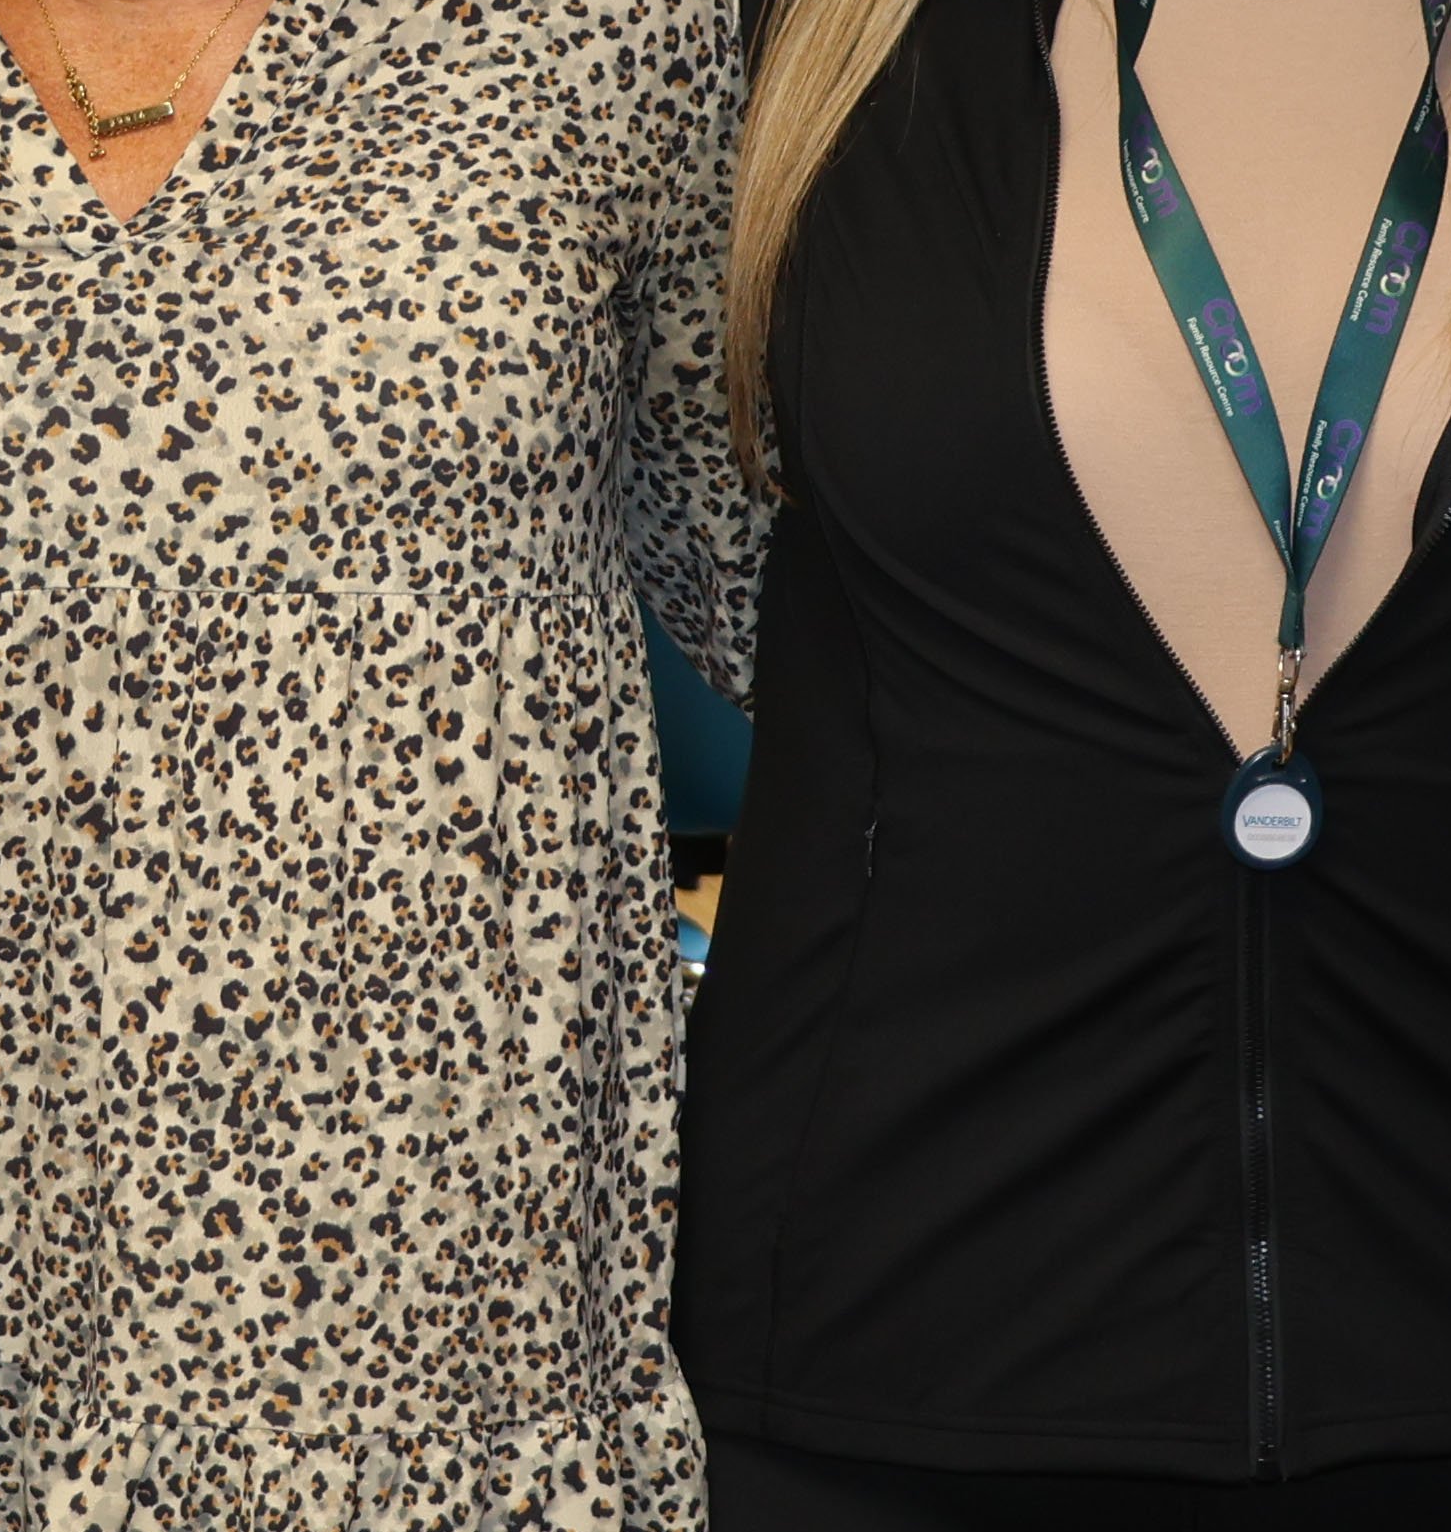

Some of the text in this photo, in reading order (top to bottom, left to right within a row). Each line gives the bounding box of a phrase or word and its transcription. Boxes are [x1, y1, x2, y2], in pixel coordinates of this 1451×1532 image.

[1135, 195, 1150, 224] Centre
[1349, 217, 1393, 322] Family Resource Centre
[1365, 220, 1430, 335] Croom
[1186, 316, 1234, 418] Family Resource Centre
[1203, 298, 1263, 416] Croom
[1296, 419, 1328, 528] Family Resource Centre
[1242, 814, 1303, 827] VANDERBILT
